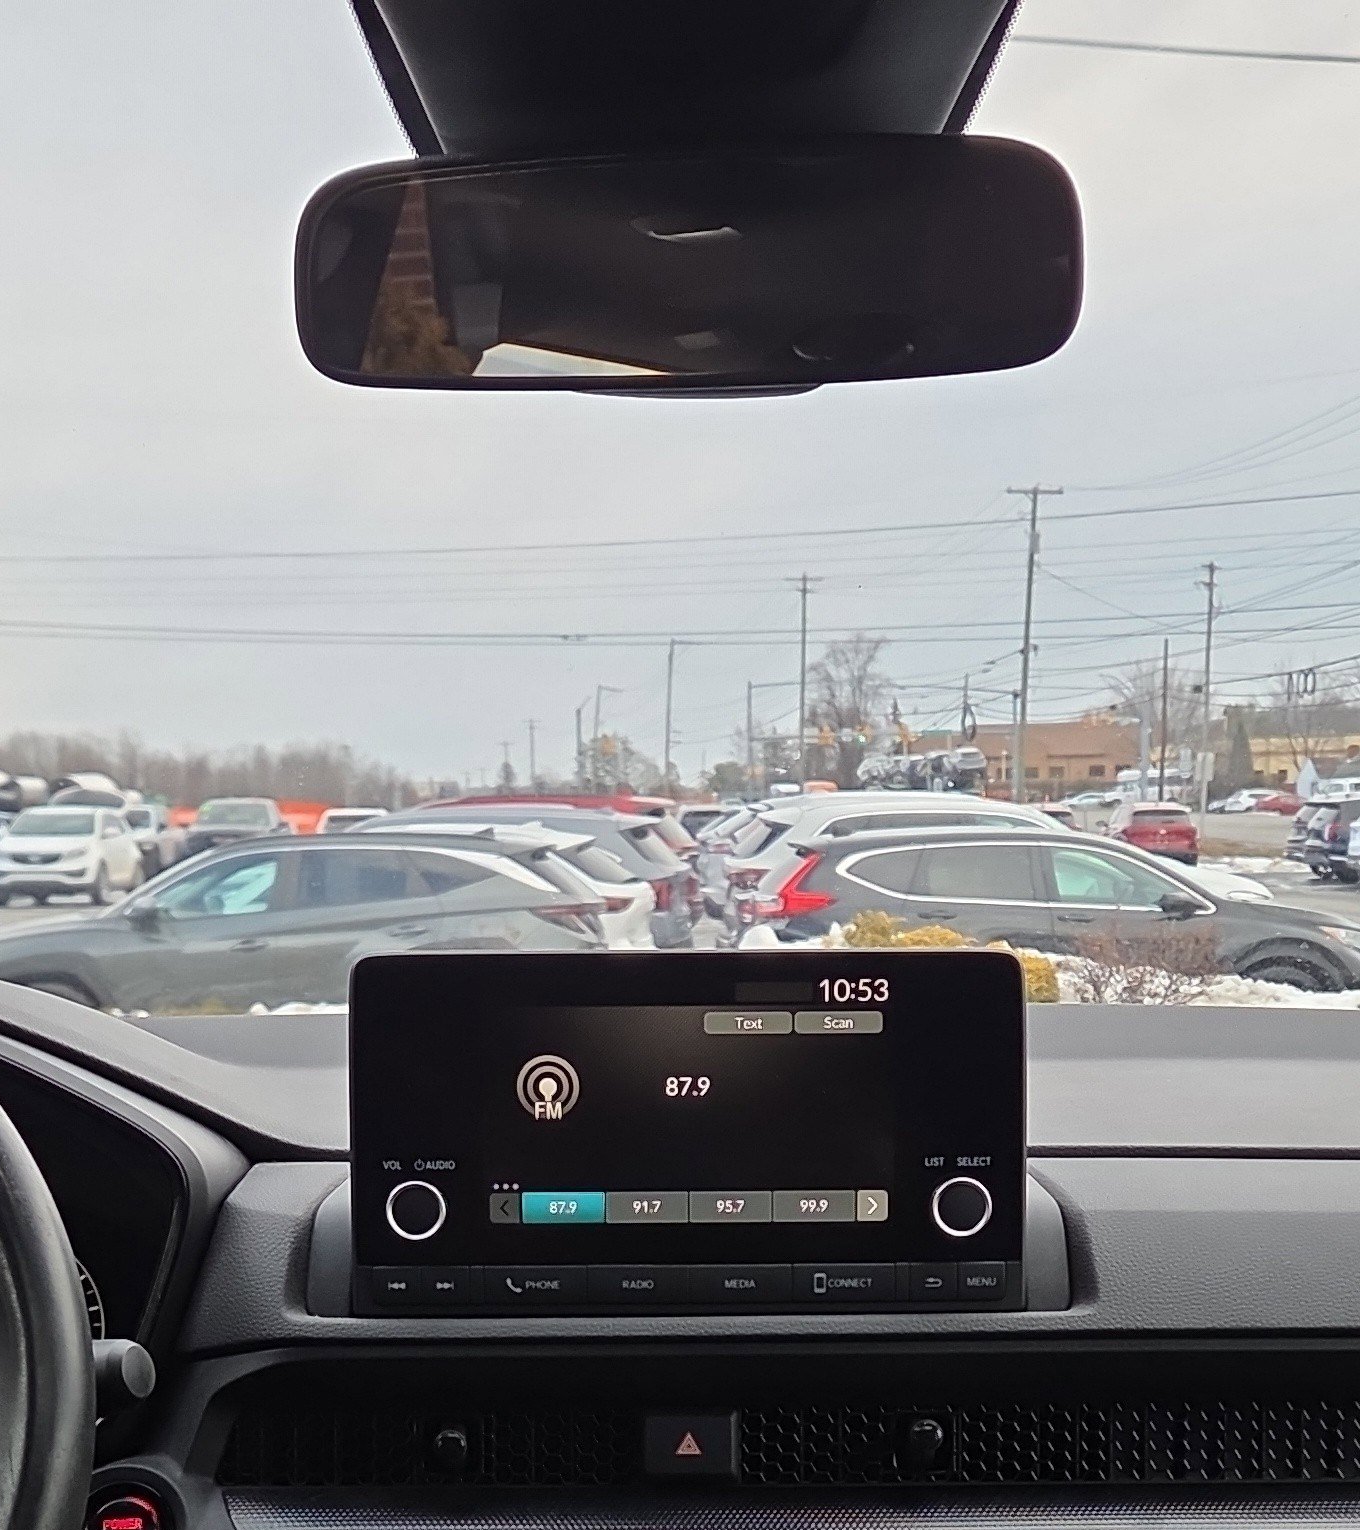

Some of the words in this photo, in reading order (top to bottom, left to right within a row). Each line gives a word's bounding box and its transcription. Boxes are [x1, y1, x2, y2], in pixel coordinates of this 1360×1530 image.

[818, 978, 890, 1003] 10:53
[734, 1016, 763, 1031] Text
[822, 1016, 854, 1030] Scan
[664, 1076, 711, 1098] 87.9
[534, 1101, 563, 1120] FM
[382, 1160, 402, 1171] VOL
[425, 1159, 456, 1171] AUDIO
[924, 1157, 945, 1167] LIST
[956, 1156, 992, 1167] SELECT
[548, 1200, 578, 1215] 87.9
[632, 1200, 662, 1214] 91.7
[716, 1199, 745, 1214] 95.7
[799, 1199, 829, 1213] 99.9
[525, 1280, 561, 1290] PHONE
[622, 1279, 655, 1290] RADIO
[724, 1278, 756, 1289] MEDIA
[827, 1277, 873, 1289] CONNECT
[966, 1276, 997, 1288] MENU
